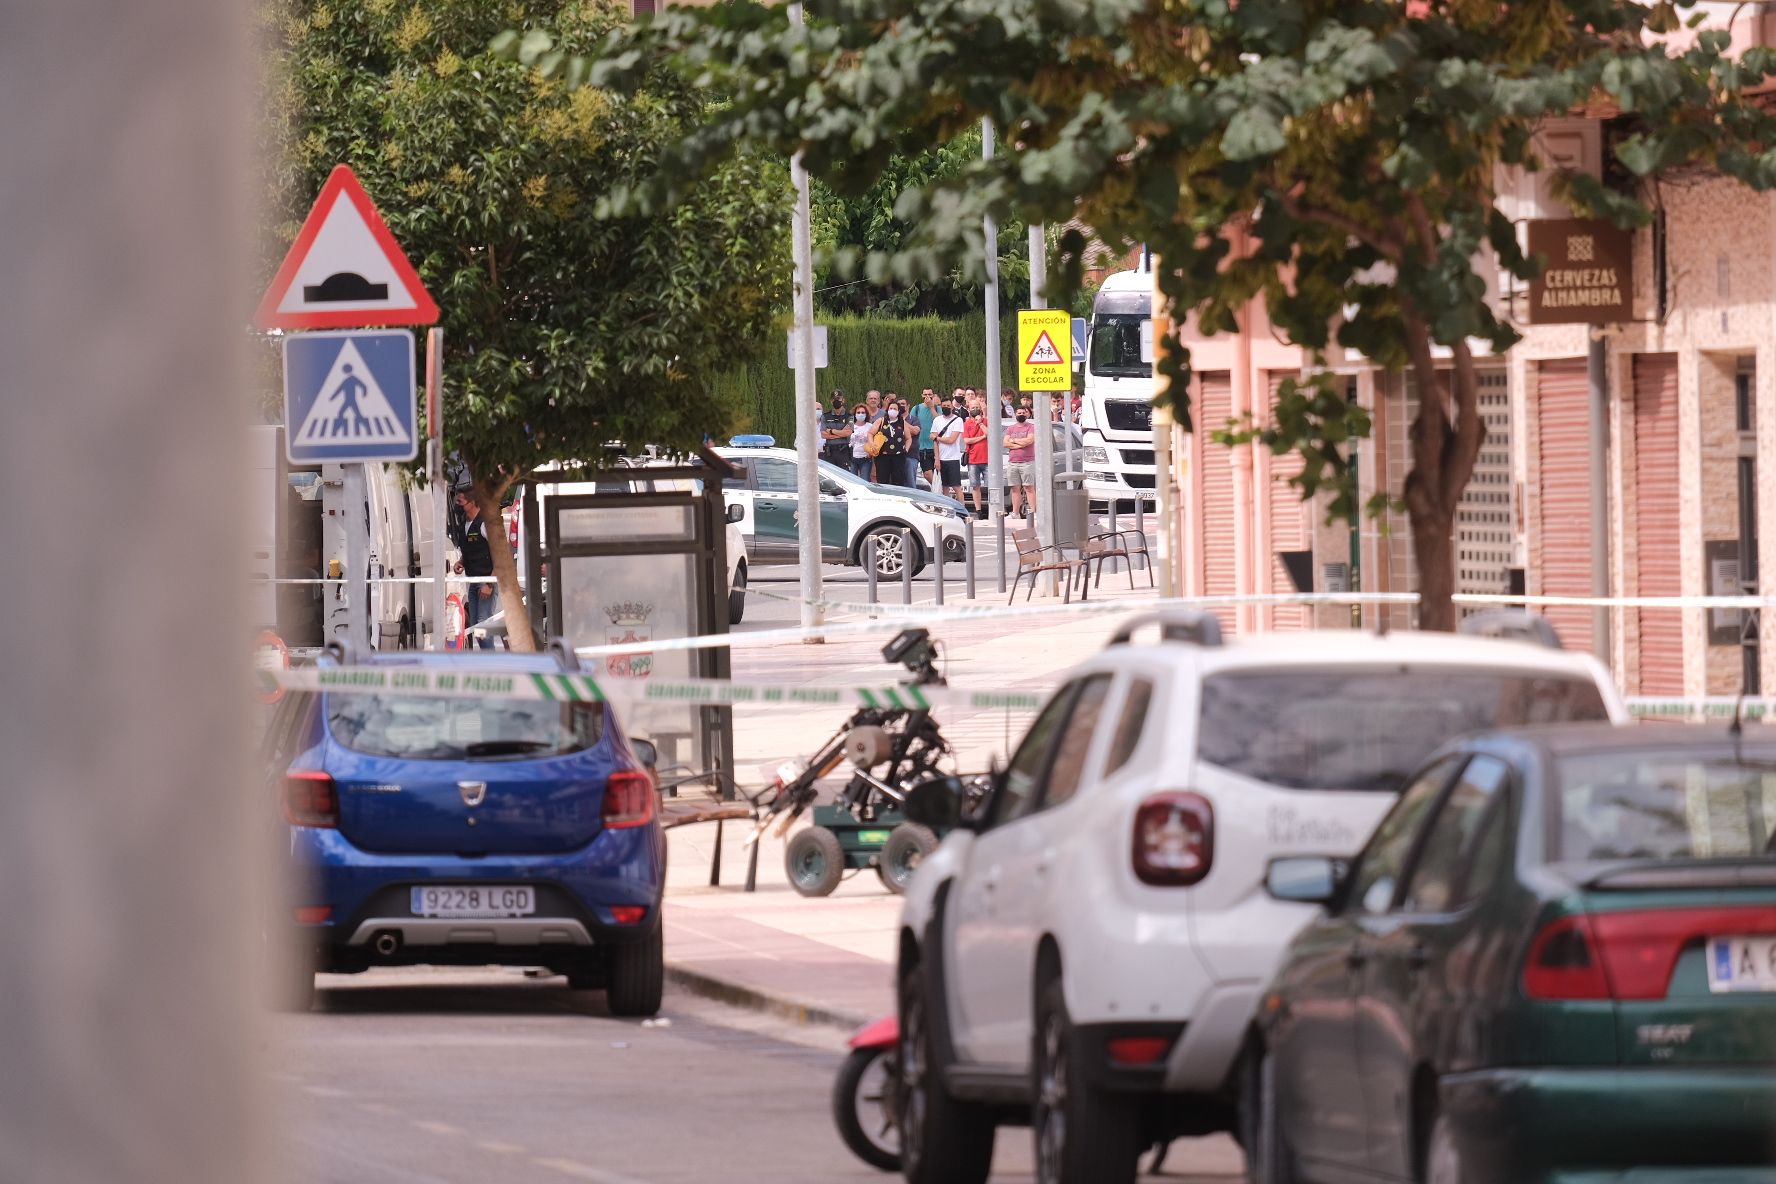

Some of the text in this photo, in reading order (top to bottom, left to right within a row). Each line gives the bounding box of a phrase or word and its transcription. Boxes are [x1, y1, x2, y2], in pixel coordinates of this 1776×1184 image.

[1545, 269, 1618, 289] CERVEZAS
[1541, 288, 1622, 307] ALHAMBRA
[1022, 316, 1066, 325] ATENCIÓN
[1025, 376, 1064, 384] ESCOLAR
[1032, 367, 1057, 375] ZONA
[319, 672, 513, 692] GUARDIA CIVIL NO PASAR
[426, 889, 528, 910] 9228 LGD
[1740, 943, 1757, 976] A
